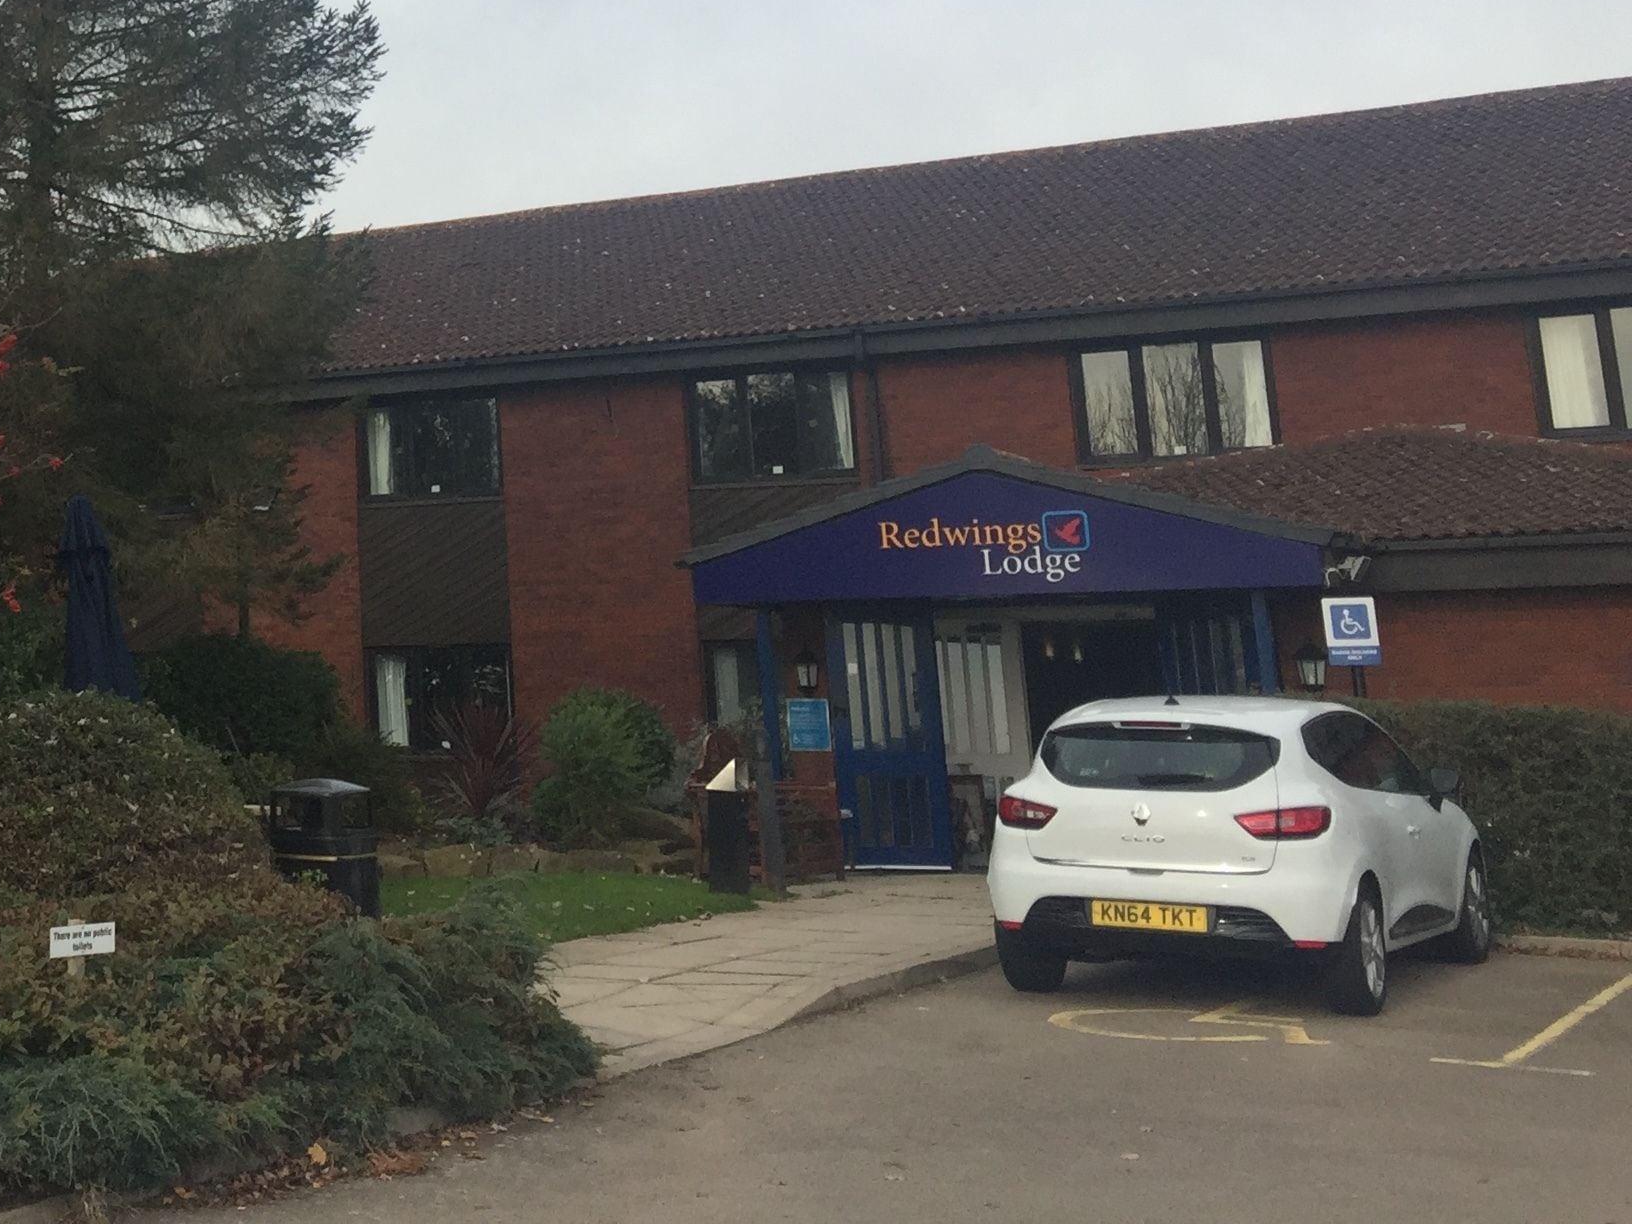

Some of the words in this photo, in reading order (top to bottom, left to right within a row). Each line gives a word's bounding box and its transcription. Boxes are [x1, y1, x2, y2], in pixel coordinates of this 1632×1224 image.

[878, 517, 1041, 554] Redwings
[981, 546, 1081, 583] Lodge
[1120, 833, 1165, 843] CLIO
[1100, 904, 1152, 925] KN64
[1158, 907, 1197, 927] TKT
[53, 932, 70, 941] There
[72, 931, 82, 939] are
[93, 927, 111, 938] public
[73, 941, 92, 951] toilets
